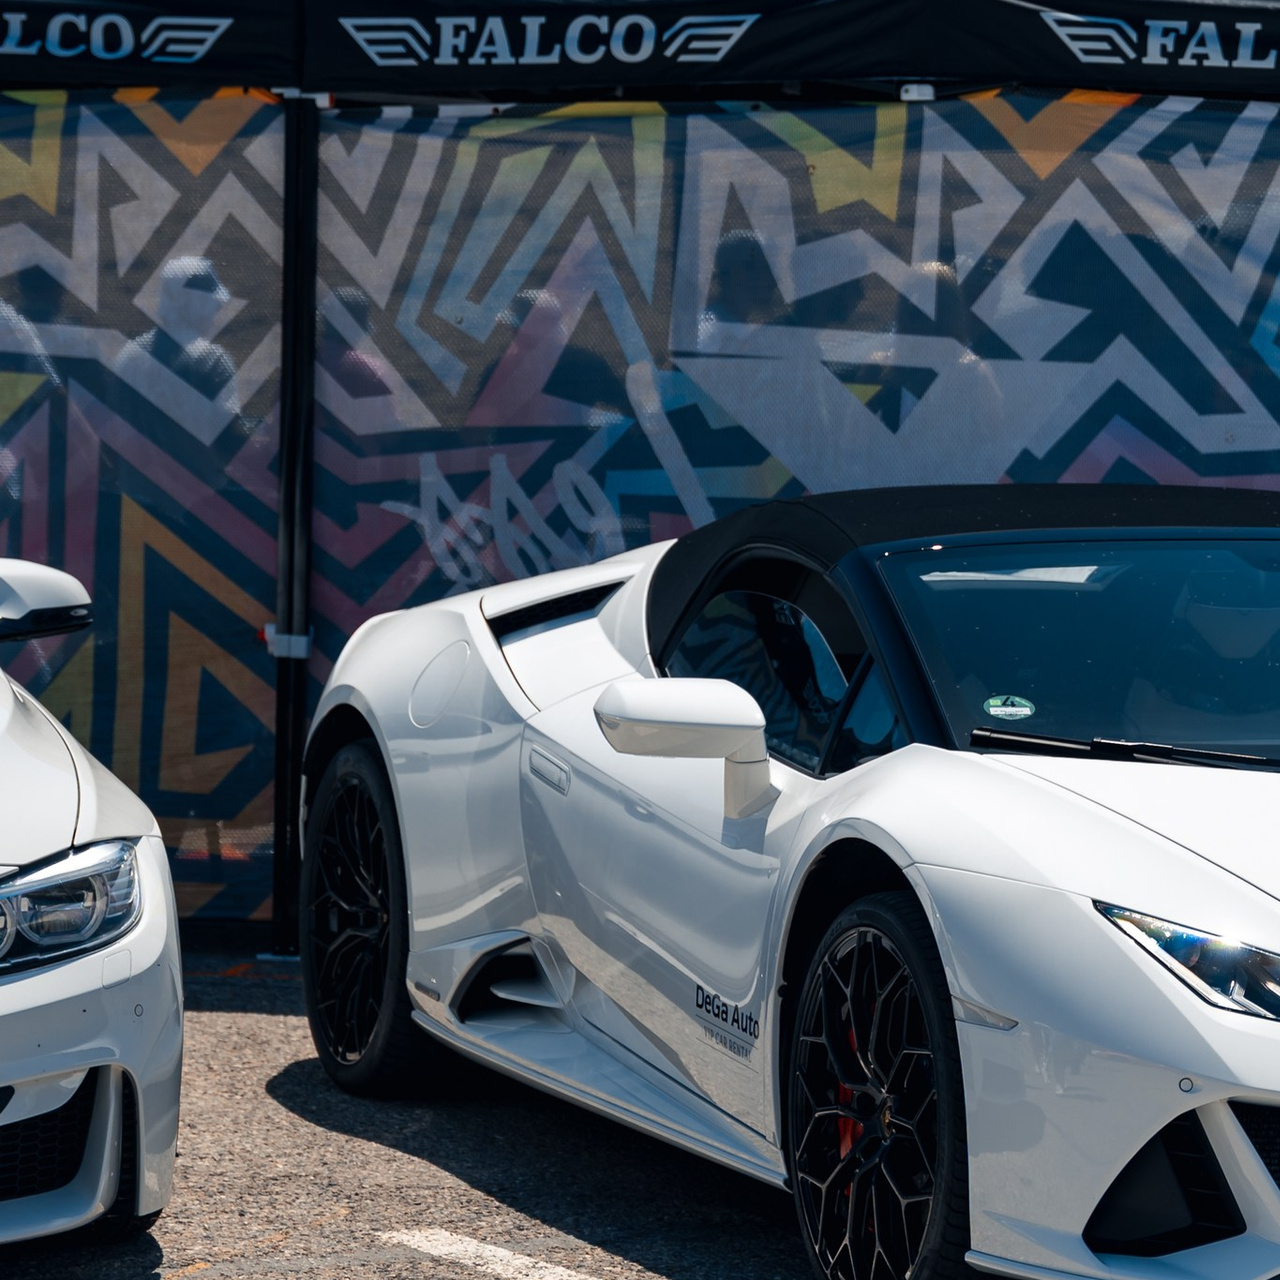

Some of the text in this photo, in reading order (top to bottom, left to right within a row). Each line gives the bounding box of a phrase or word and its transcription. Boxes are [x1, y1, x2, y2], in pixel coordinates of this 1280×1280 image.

[0, 13, 135, 59] LCO
[434, 16, 655, 64] FALCO
[695, 984, 760, 1039] DeGa Auto
[714, 1029, 728, 1051] CAR
